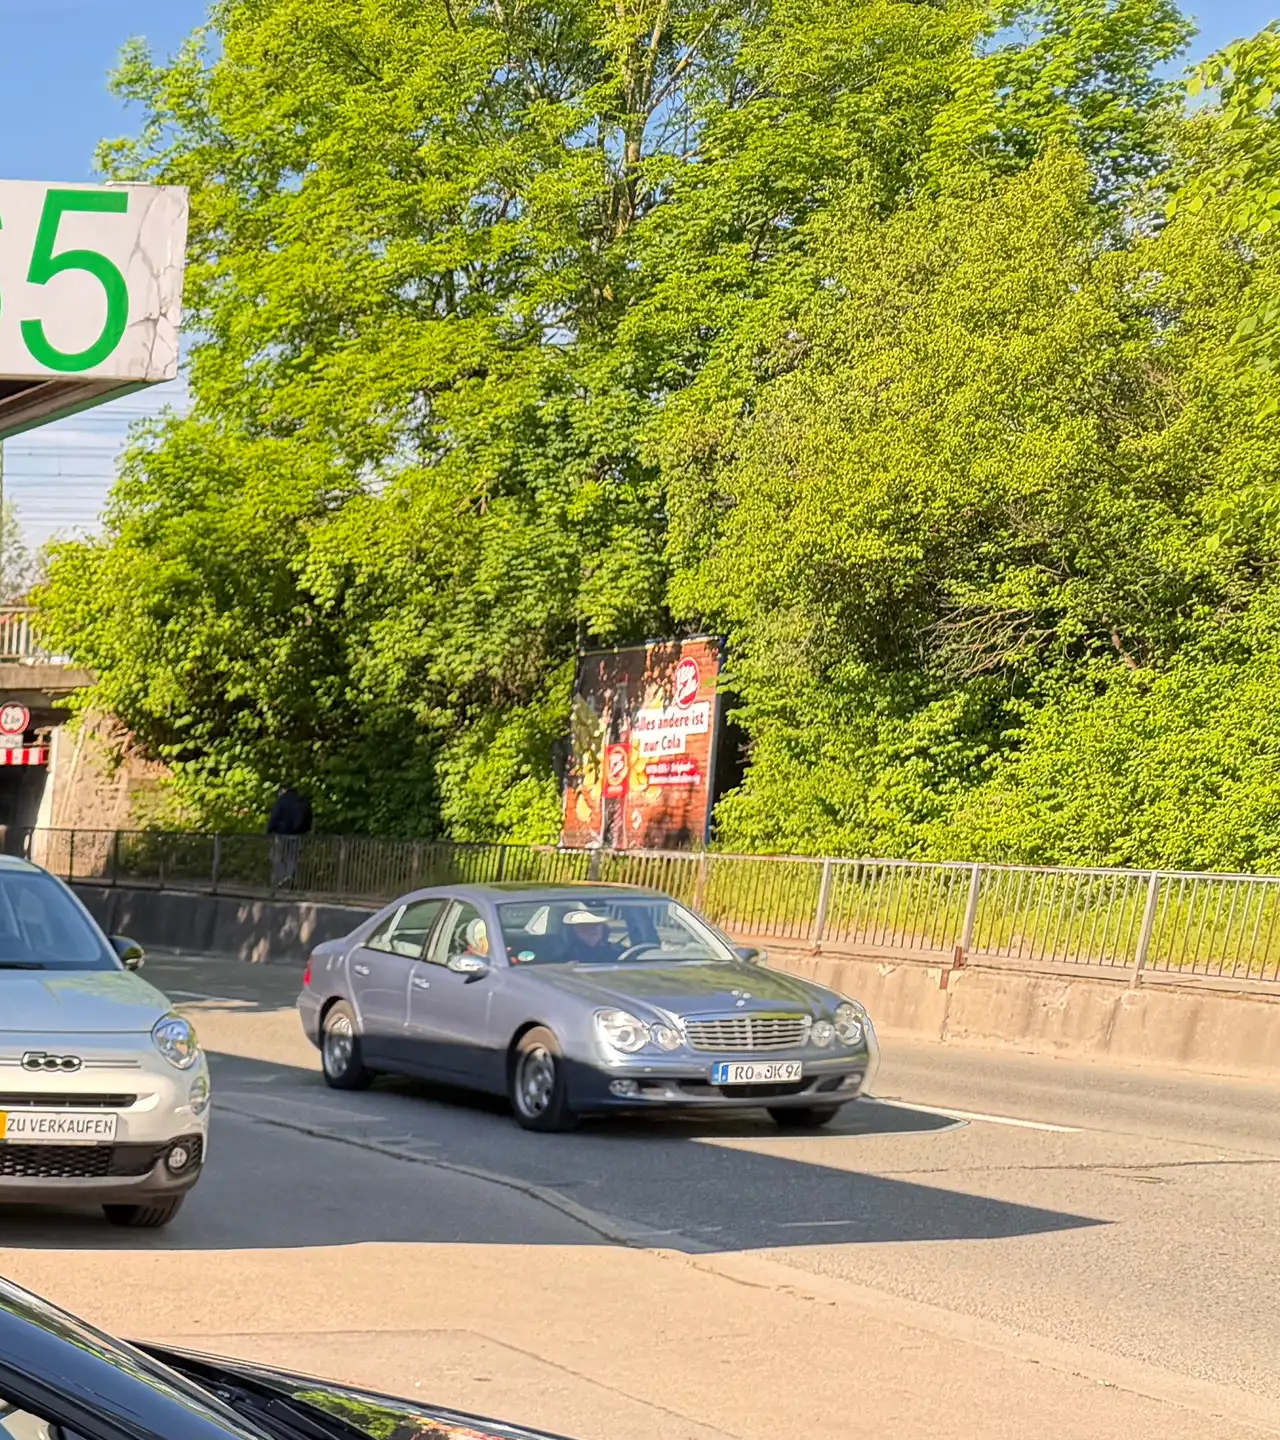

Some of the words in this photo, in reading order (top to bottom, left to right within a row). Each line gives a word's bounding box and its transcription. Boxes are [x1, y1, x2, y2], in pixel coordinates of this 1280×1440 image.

[658, 712, 689, 728] andere
[692, 710, 704, 725] ist
[644, 740, 659, 752] nur
[661, 734, 681, 751] Cola
[6, 1117, 26, 1132] ZU
[30, 1118, 113, 1134] VERKAUFEN
